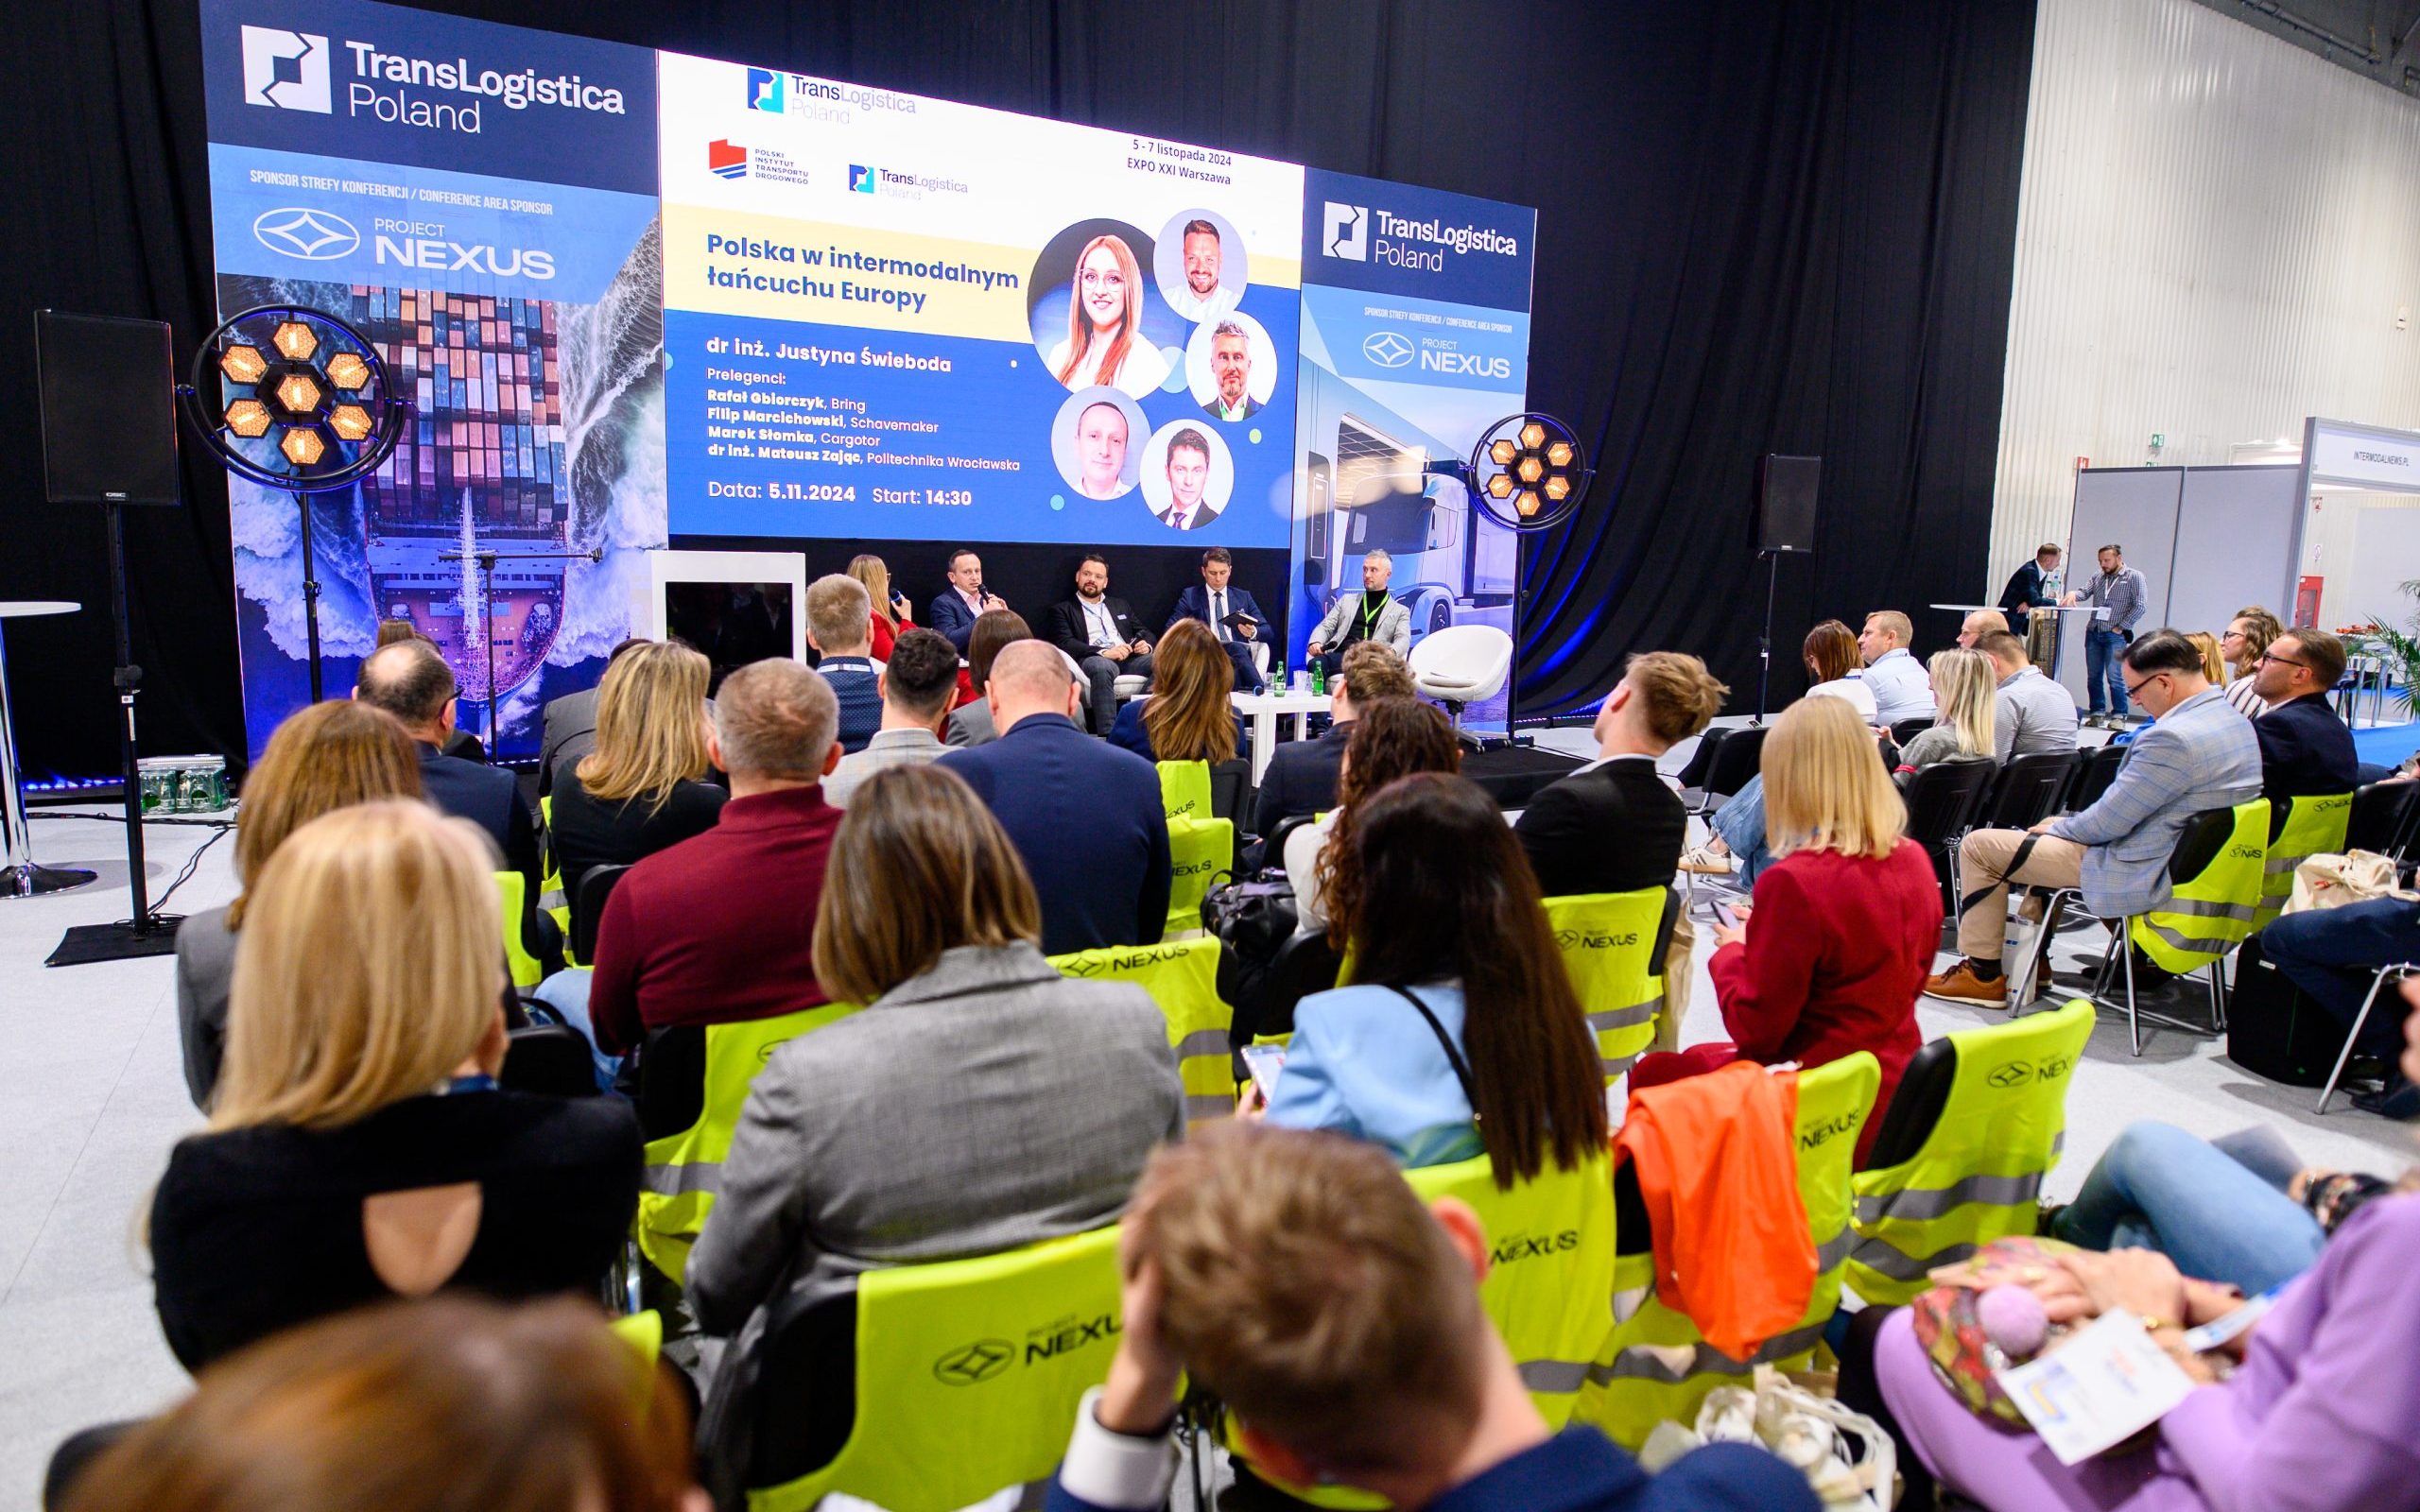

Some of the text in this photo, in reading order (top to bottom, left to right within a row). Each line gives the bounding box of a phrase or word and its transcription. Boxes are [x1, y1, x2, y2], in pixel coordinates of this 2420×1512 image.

[345, 40, 626, 115] TransLogistica
[349, 83, 481, 133] Poland
[791, 76, 916, 113] TransLogistica
[791, 97, 851, 125] Poland
[755, 148, 785, 159] POLSKI
[755, 157, 795, 167] INSTYTUT
[1132, 139, 1139, 150] 5
[1148, 142, 1154, 153] 7
[1157, 143, 1205, 162] listopada
[1208, 153, 1232, 166] 2024
[755, 164, 809, 178] TRANSPORTU
[755, 172, 809, 185] DROGOWEGO
[879, 169, 969, 194] TransLogistica
[1127, 158, 1231, 185] EXPO XXI Warszawa
[251, 169, 300, 187] SPONSOR
[301, 175, 340, 192] STREFY
[342, 180, 409, 198] KONFERENCJI
[419, 189, 481, 207] CONFERENCE
[483, 196, 509, 210] AREA
[510, 199, 554, 215] SPONSOR
[374, 217, 445, 238] PROJECT
[1376, 209, 1517, 257] TransLogistica
[376, 236, 556, 280] NEXUS
[707, 233, 1019, 291] Polska w intermodalnym
[1374, 239, 1443, 272] Poland
[707, 266, 927, 314] łańcuchu Europy
[706, 336, 952, 372] dr inż. Justyna Świeboda
[1422, 337, 1458, 351] PROJECT
[707, 368, 787, 386] Prelegenci:
[1421, 350, 1511, 379] NEXUS
[707, 388, 748, 404] Rafał
[830, 398, 866, 414] Bring
[707, 407, 939, 433] Filip Marcichowski, Schavemaker
[707, 426, 880, 448] Marek Słomka, Cargotor
[707, 443, 1021, 471] dr inż. Mateusz Zając, Politechnika Wrocławska
[708, 481, 973, 507] Data: 5.11.2024 Start: 14:30
[1167, 799, 1196, 819] EXUS
[1582, 933, 1638, 949] NEXUS
[1490, 1229, 1578, 1266] NEXUS
[1026, 1313, 1124, 1366] NEXU
